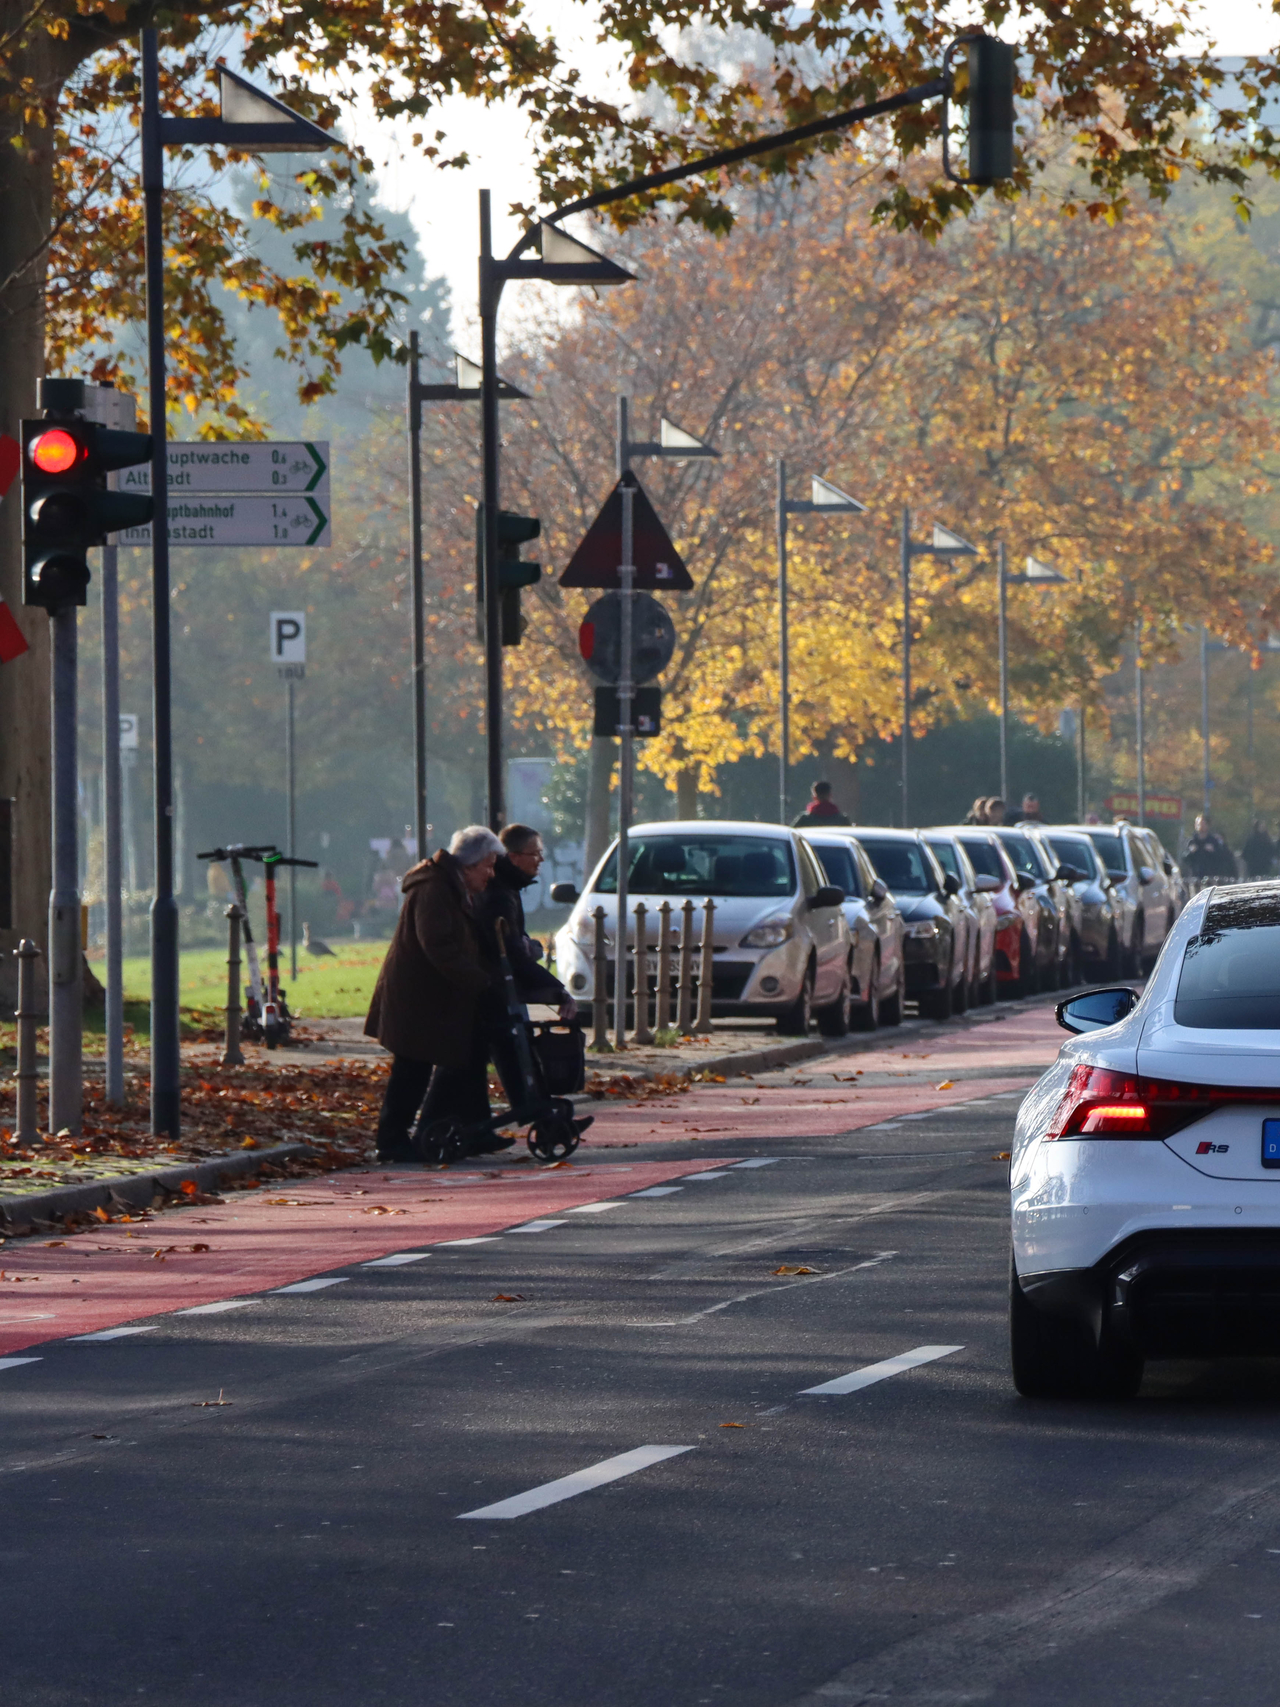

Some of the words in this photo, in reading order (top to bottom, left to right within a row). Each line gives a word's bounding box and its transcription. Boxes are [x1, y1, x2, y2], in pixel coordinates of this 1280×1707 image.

[167, 450, 250, 468] uptwache
[126, 470, 191, 486] Altadt
[125, 524, 215, 540] Innstadt
[276, 618, 301, 656] P
